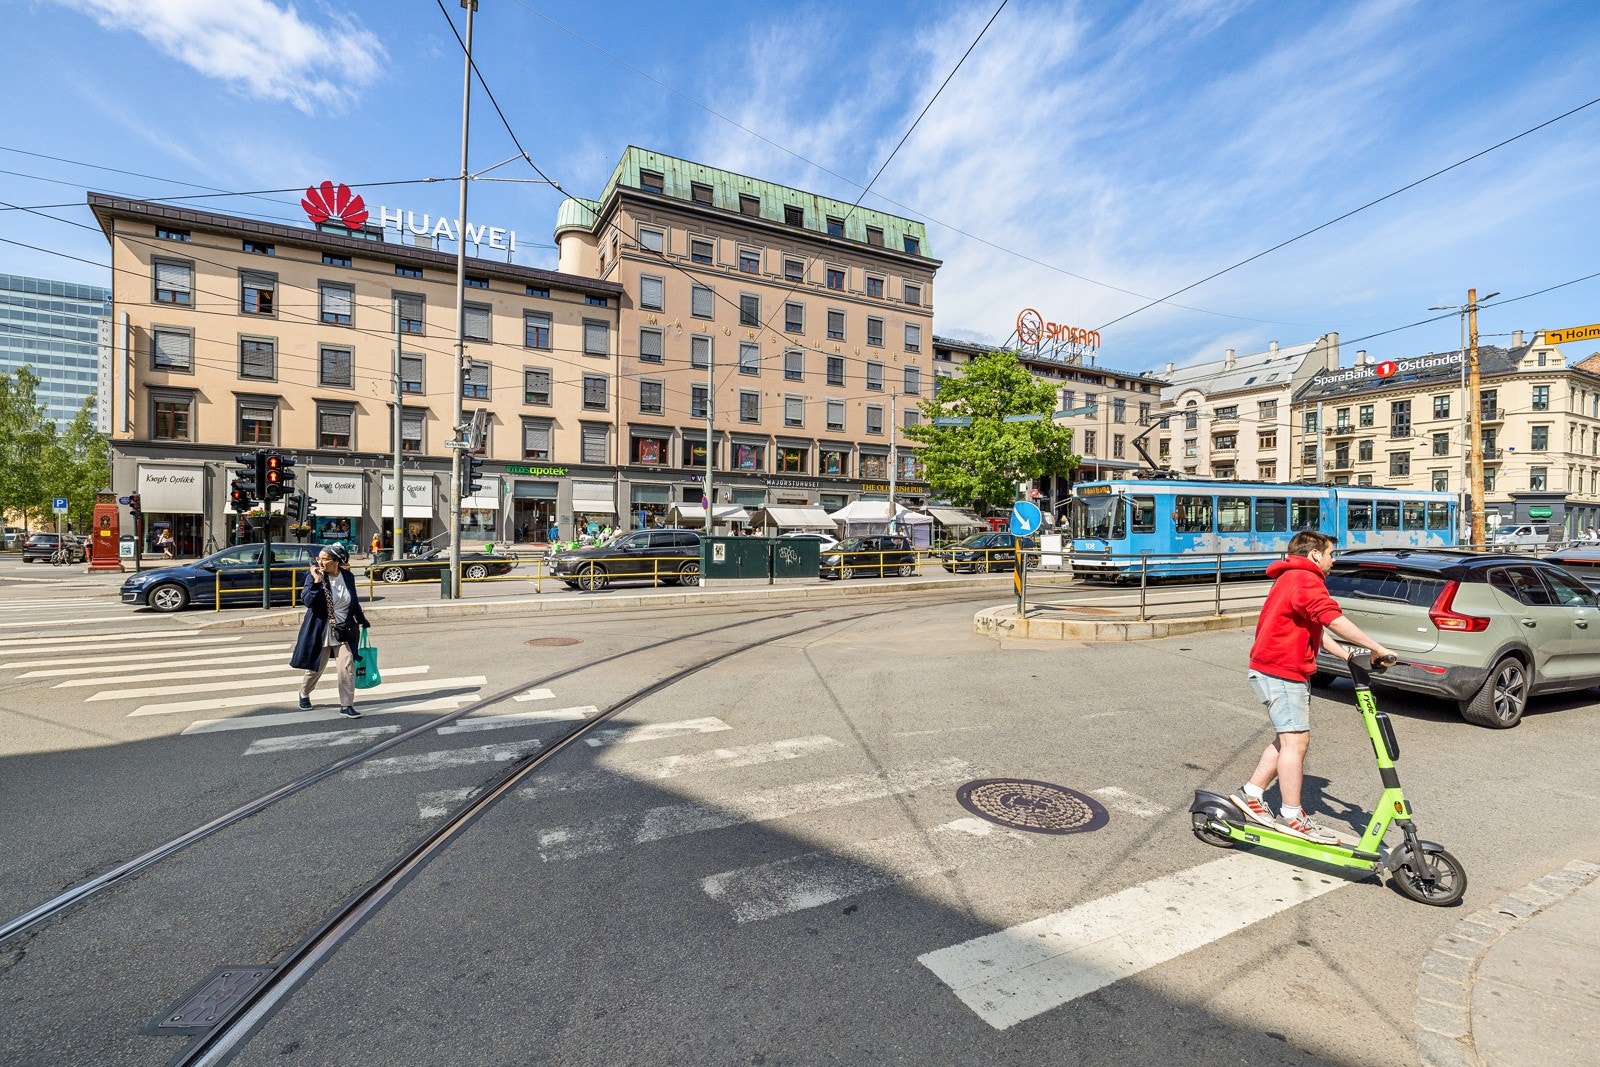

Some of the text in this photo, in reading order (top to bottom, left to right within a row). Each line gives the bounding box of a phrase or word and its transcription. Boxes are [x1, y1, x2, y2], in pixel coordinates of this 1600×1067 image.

[380, 205, 516, 252] HUAWEI
[1046, 321, 1101, 348] SYNSAM
[1313, 368, 1375, 386] SpareBank
[1397, 353, 1464, 372] Østlandet
[861, 484, 876, 492] THE
[56, 499, 64, 508] P
[1363, 693, 1375, 715] ryde
